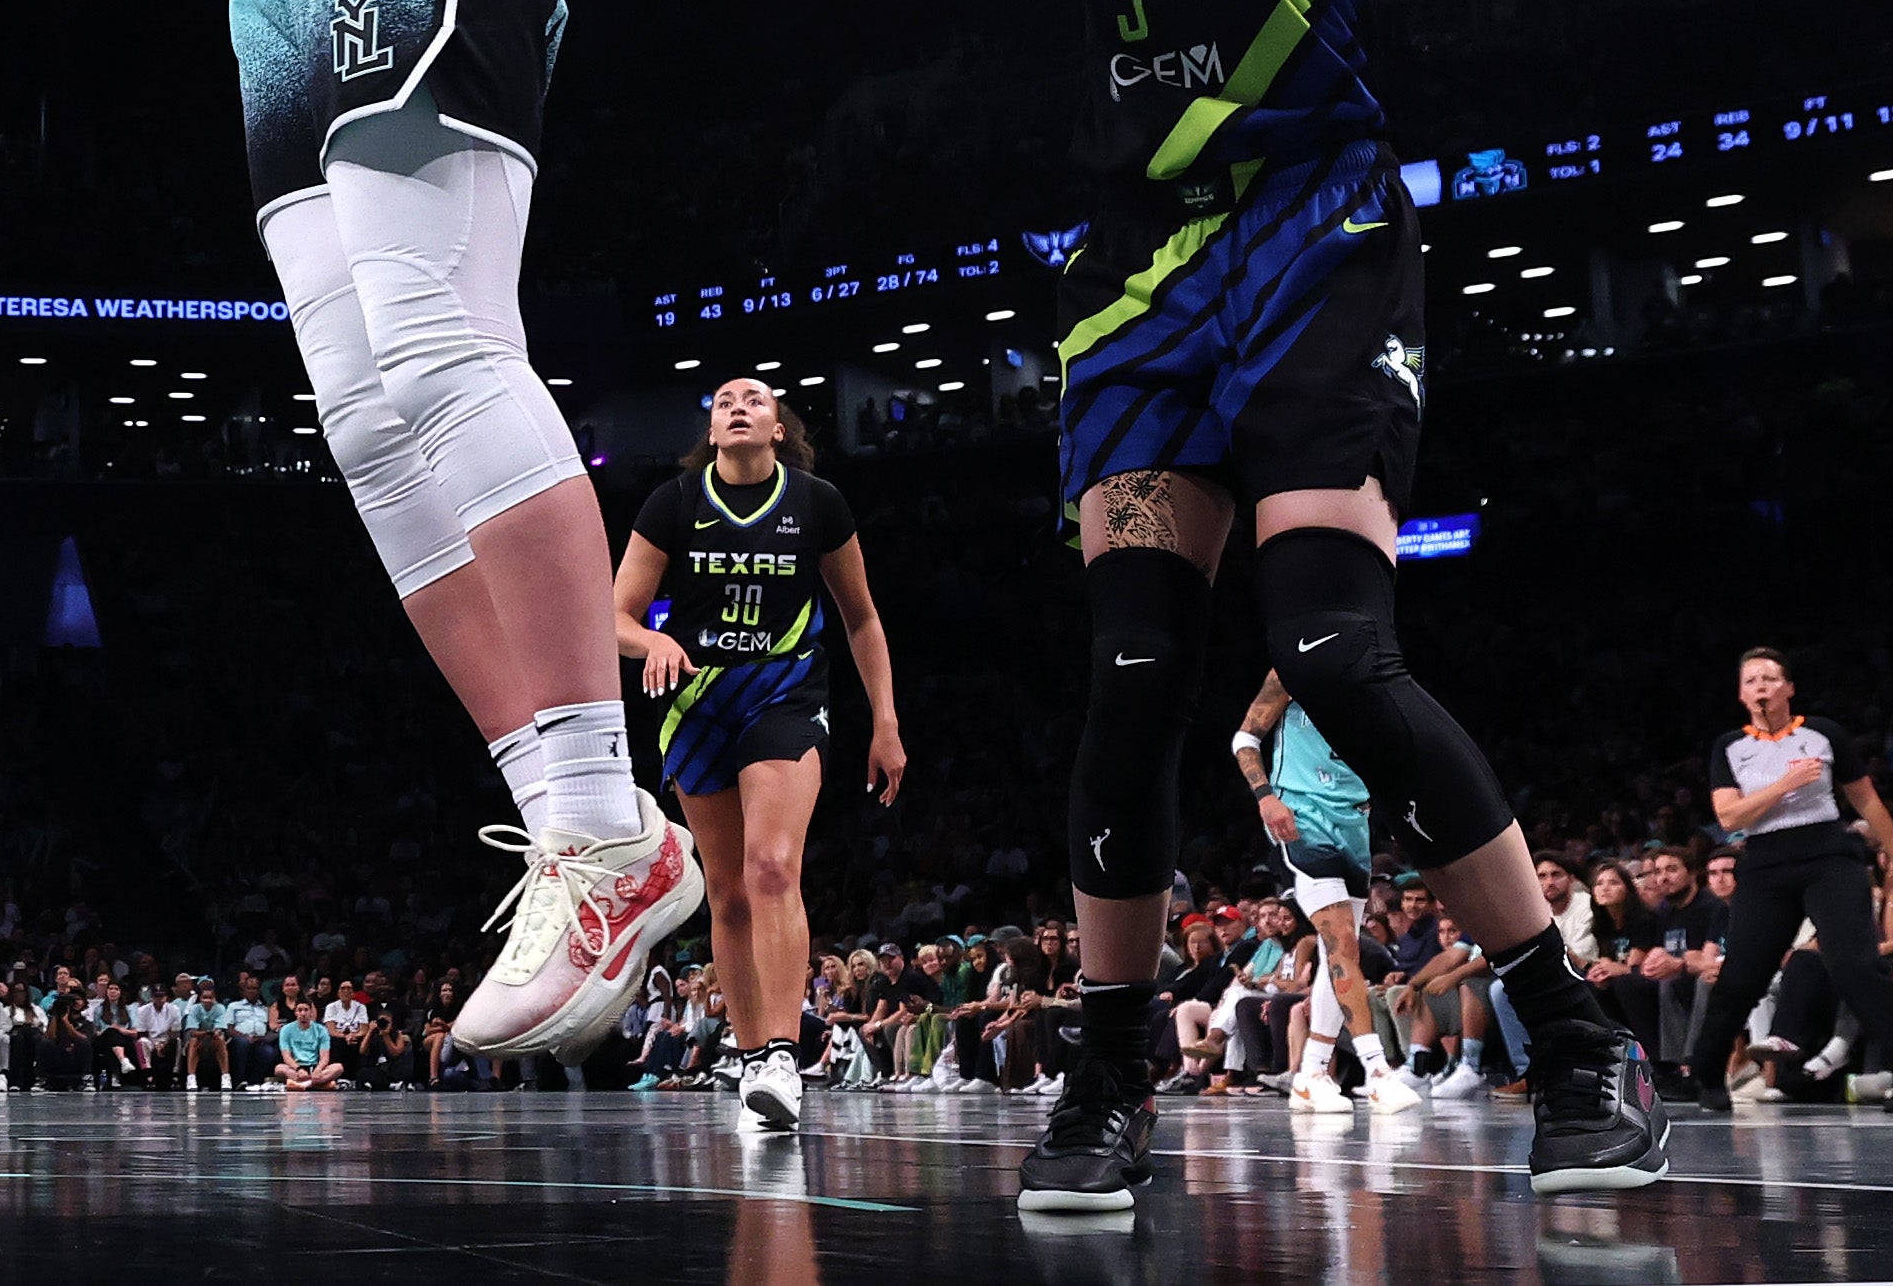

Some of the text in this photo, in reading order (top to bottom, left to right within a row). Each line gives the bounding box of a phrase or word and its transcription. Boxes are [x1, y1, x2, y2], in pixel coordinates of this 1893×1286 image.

[1110, 41, 1225, 90] GEM
[1877, 106, 1893, 124] 1
[1586, 134, 1601, 151] 2
[1717, 129, 1751, 151] 34
[1650, 141, 1684, 163] 24
[1590, 159, 1600, 175] 1
[987, 238, 999, 252] 4
[896, 253, 915, 265] FG
[958, 260, 1000, 277] TOL: 2
[761, 277, 775, 288] FT
[654, 293, 678, 306] AST
[700, 286, 723, 299] REB
[94, 298, 289, 321] WEATHERSPOO
[700, 304, 722, 319] 43
[656, 312, 676, 327] 19
[775, 525, 800, 535] Albert
[688, 551, 797, 576] TEXAS
[721, 583, 763, 626] 30
[717, 631, 772, 652] GEM
